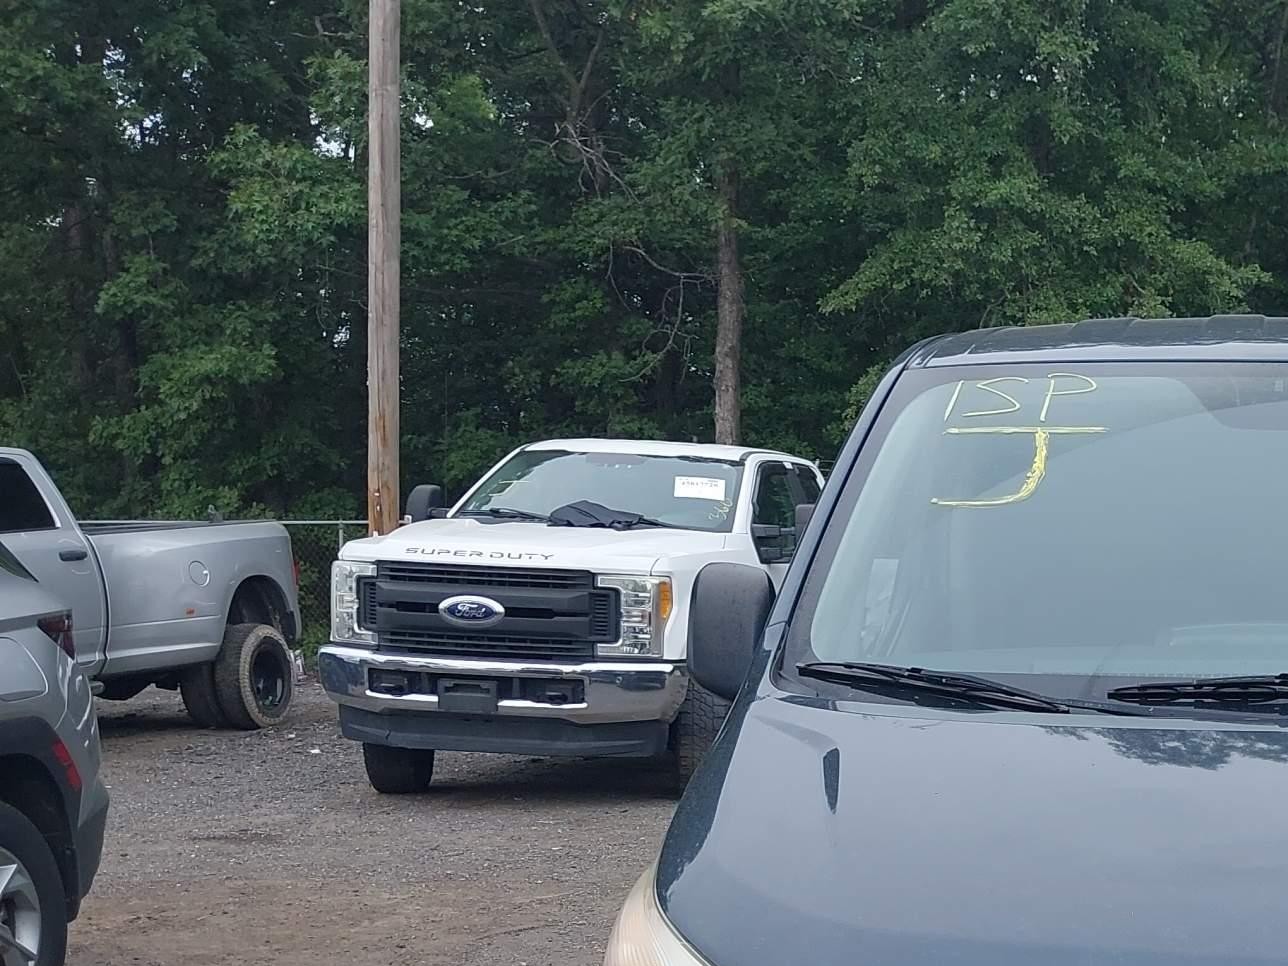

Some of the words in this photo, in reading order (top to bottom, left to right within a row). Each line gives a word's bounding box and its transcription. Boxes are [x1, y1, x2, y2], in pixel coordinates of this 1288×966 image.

[405, 547, 484, 557] SUPER
[489, 551, 554, 560] DUTY
[455, 603, 486, 618] Ford
